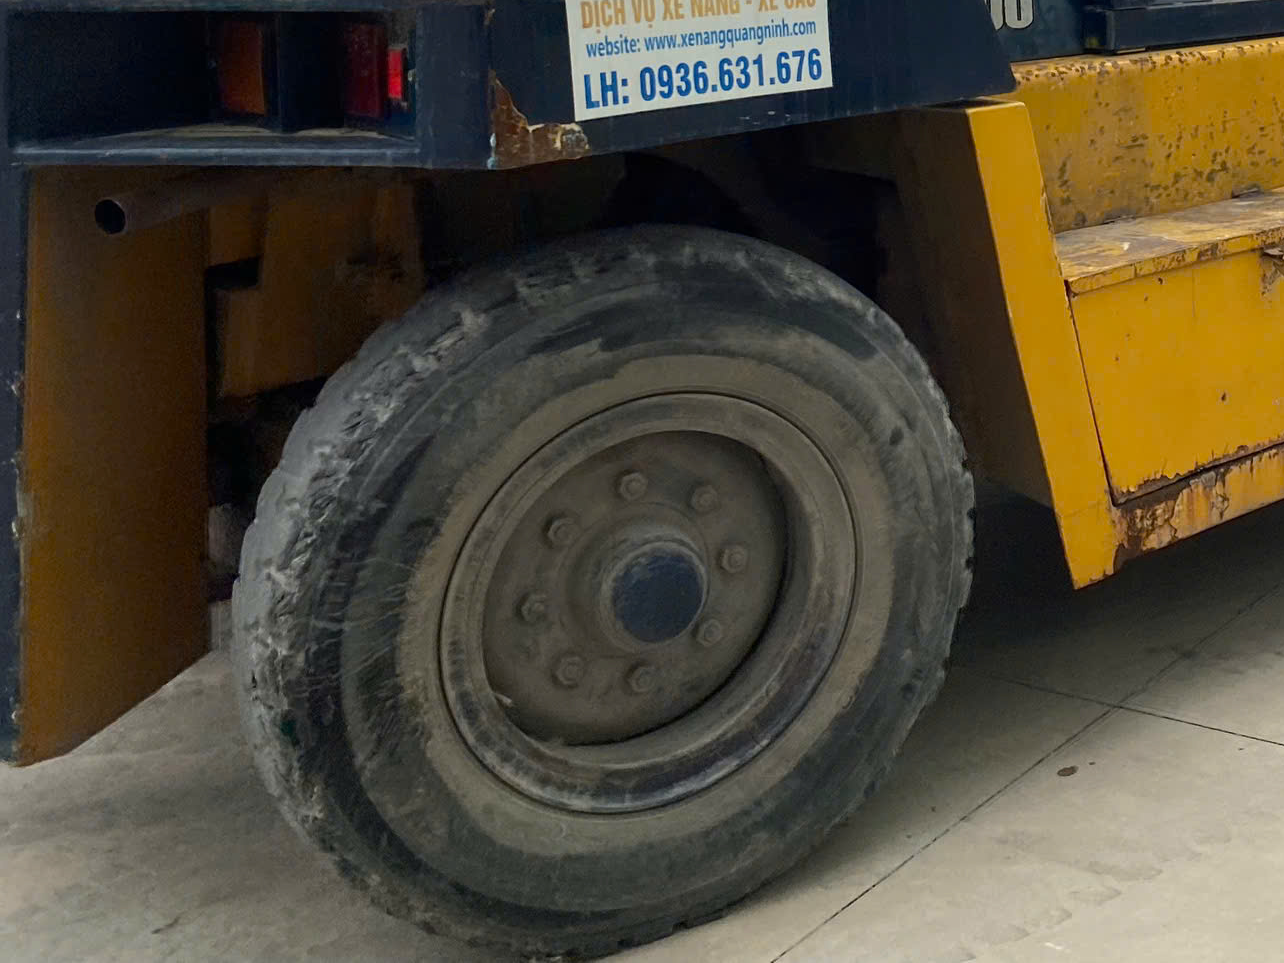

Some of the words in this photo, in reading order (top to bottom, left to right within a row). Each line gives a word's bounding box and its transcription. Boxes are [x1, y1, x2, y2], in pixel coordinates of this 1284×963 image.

[585, 33, 641, 58] website:
[644, 18, 818, 53] www.xenangquangninh.com
[583, 70, 630, 110] LH:
[640, 48, 823, 102] 0936.631.676
